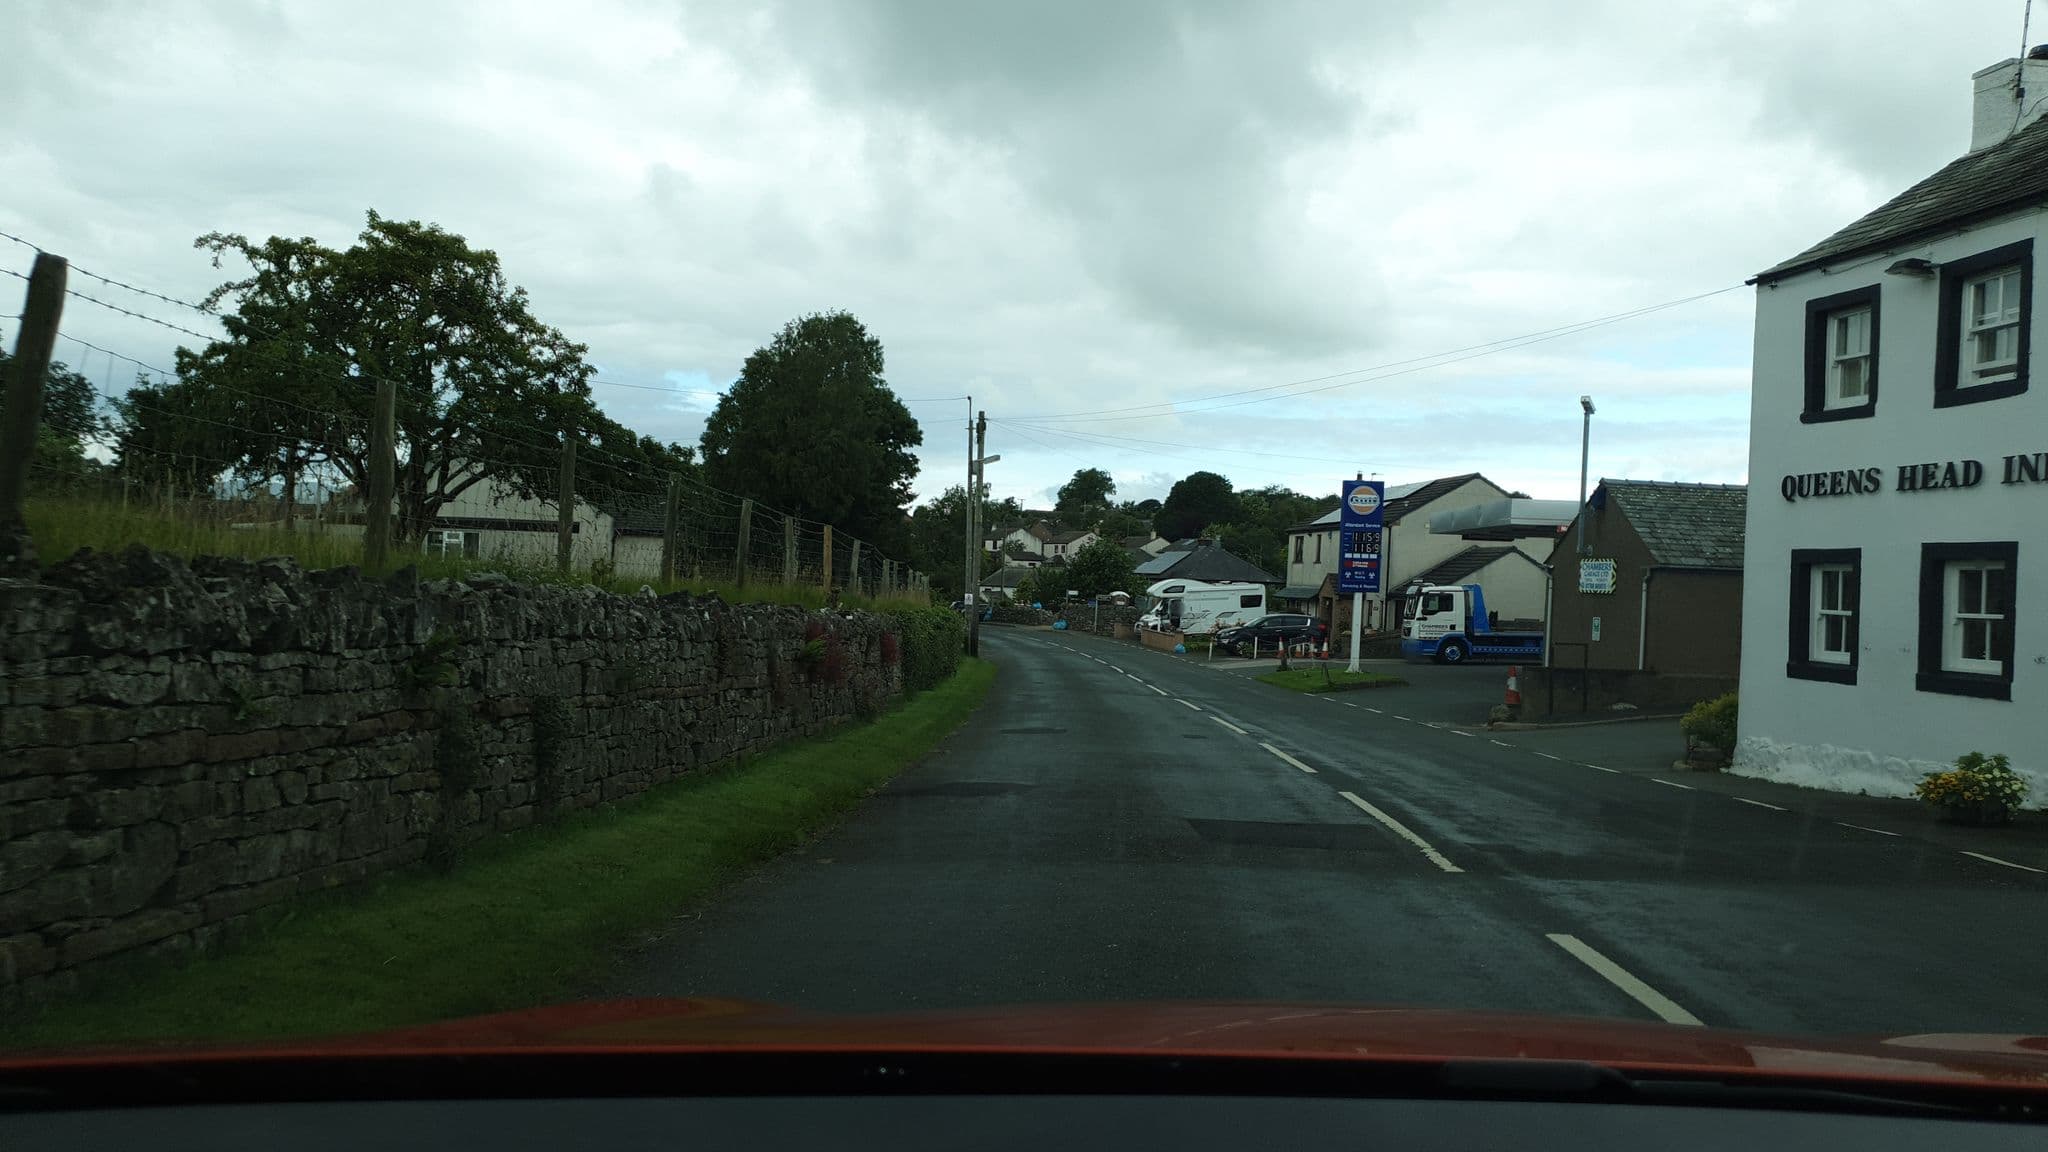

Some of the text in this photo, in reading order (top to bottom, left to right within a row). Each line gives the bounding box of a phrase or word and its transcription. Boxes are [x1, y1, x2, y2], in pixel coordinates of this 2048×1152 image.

[1781, 452, 2048, 502] QUEENS HEAD IN
